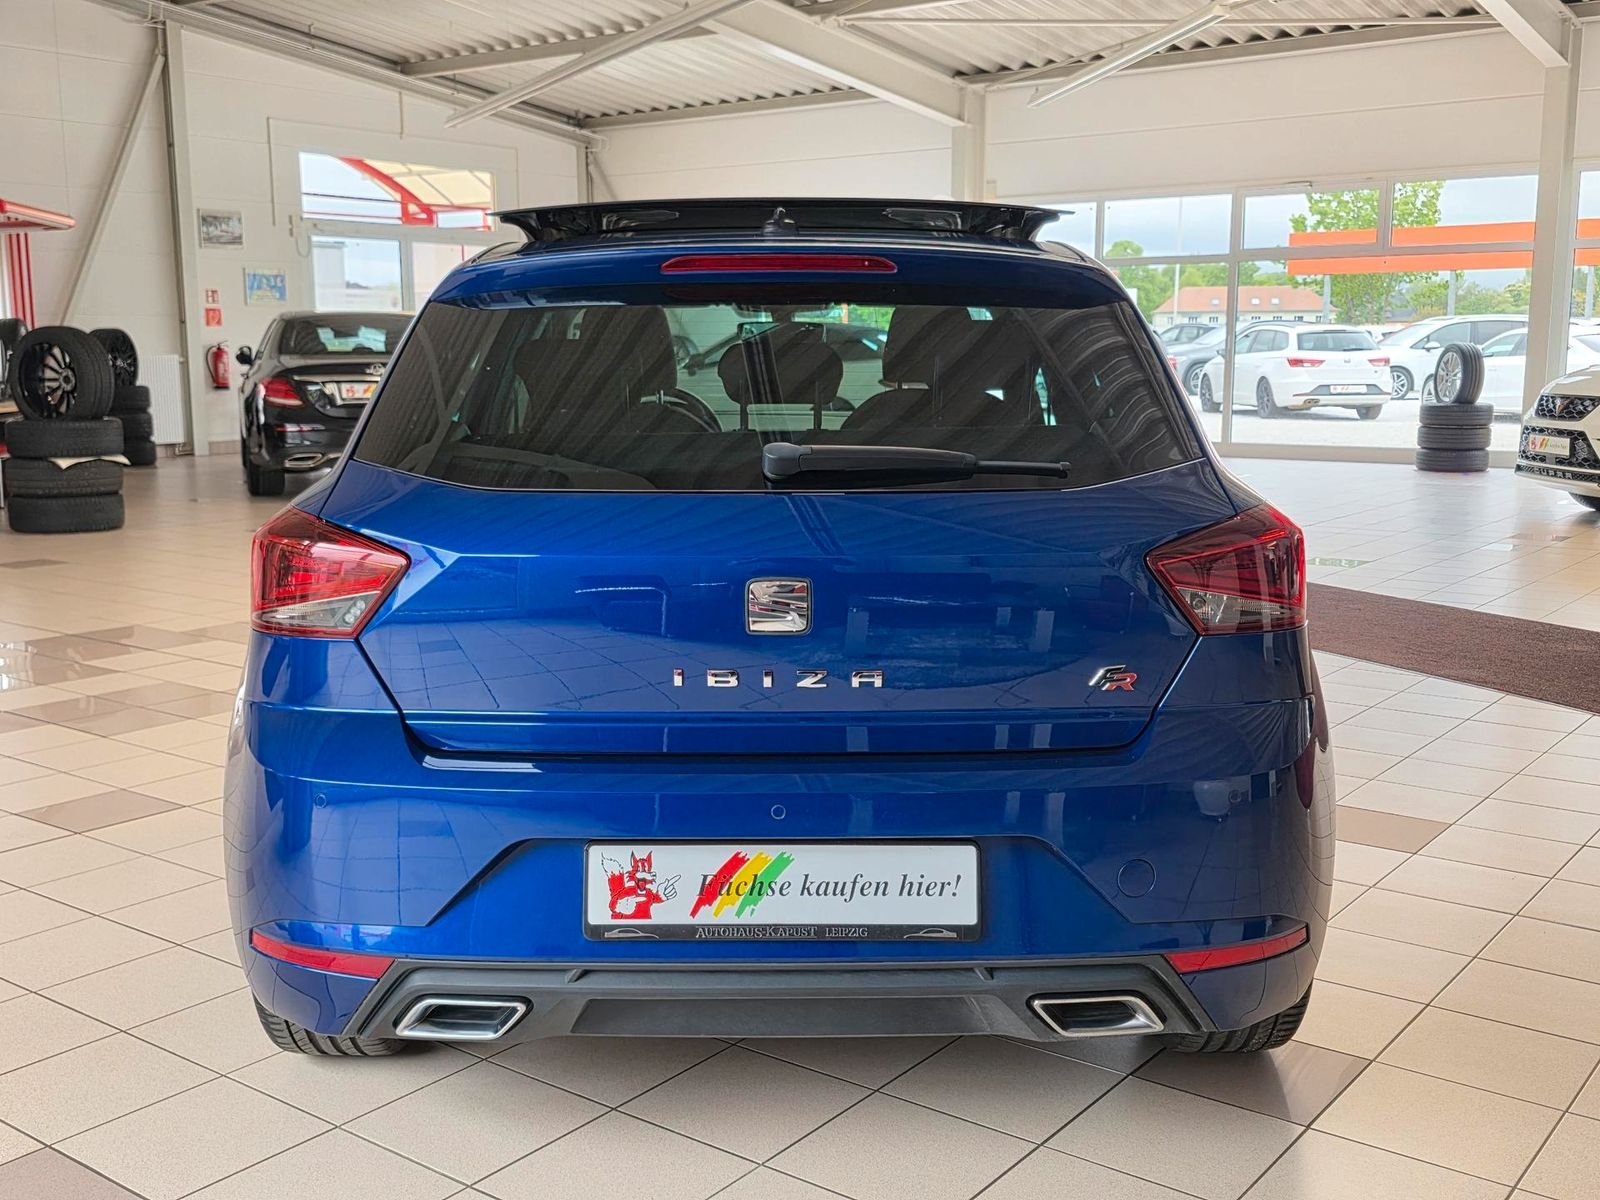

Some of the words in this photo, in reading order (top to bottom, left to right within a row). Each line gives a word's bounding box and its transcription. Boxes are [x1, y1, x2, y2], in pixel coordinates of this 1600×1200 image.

[673, 669, 884, 689] IBIZA
[1088, 664, 1138, 691] FR
[697, 873, 792, 897] Füchse
[800, 873, 889, 903] kaufen
[899, 873, 962, 897] hier!
[825, 927, 869, 937] LEIPZIG
